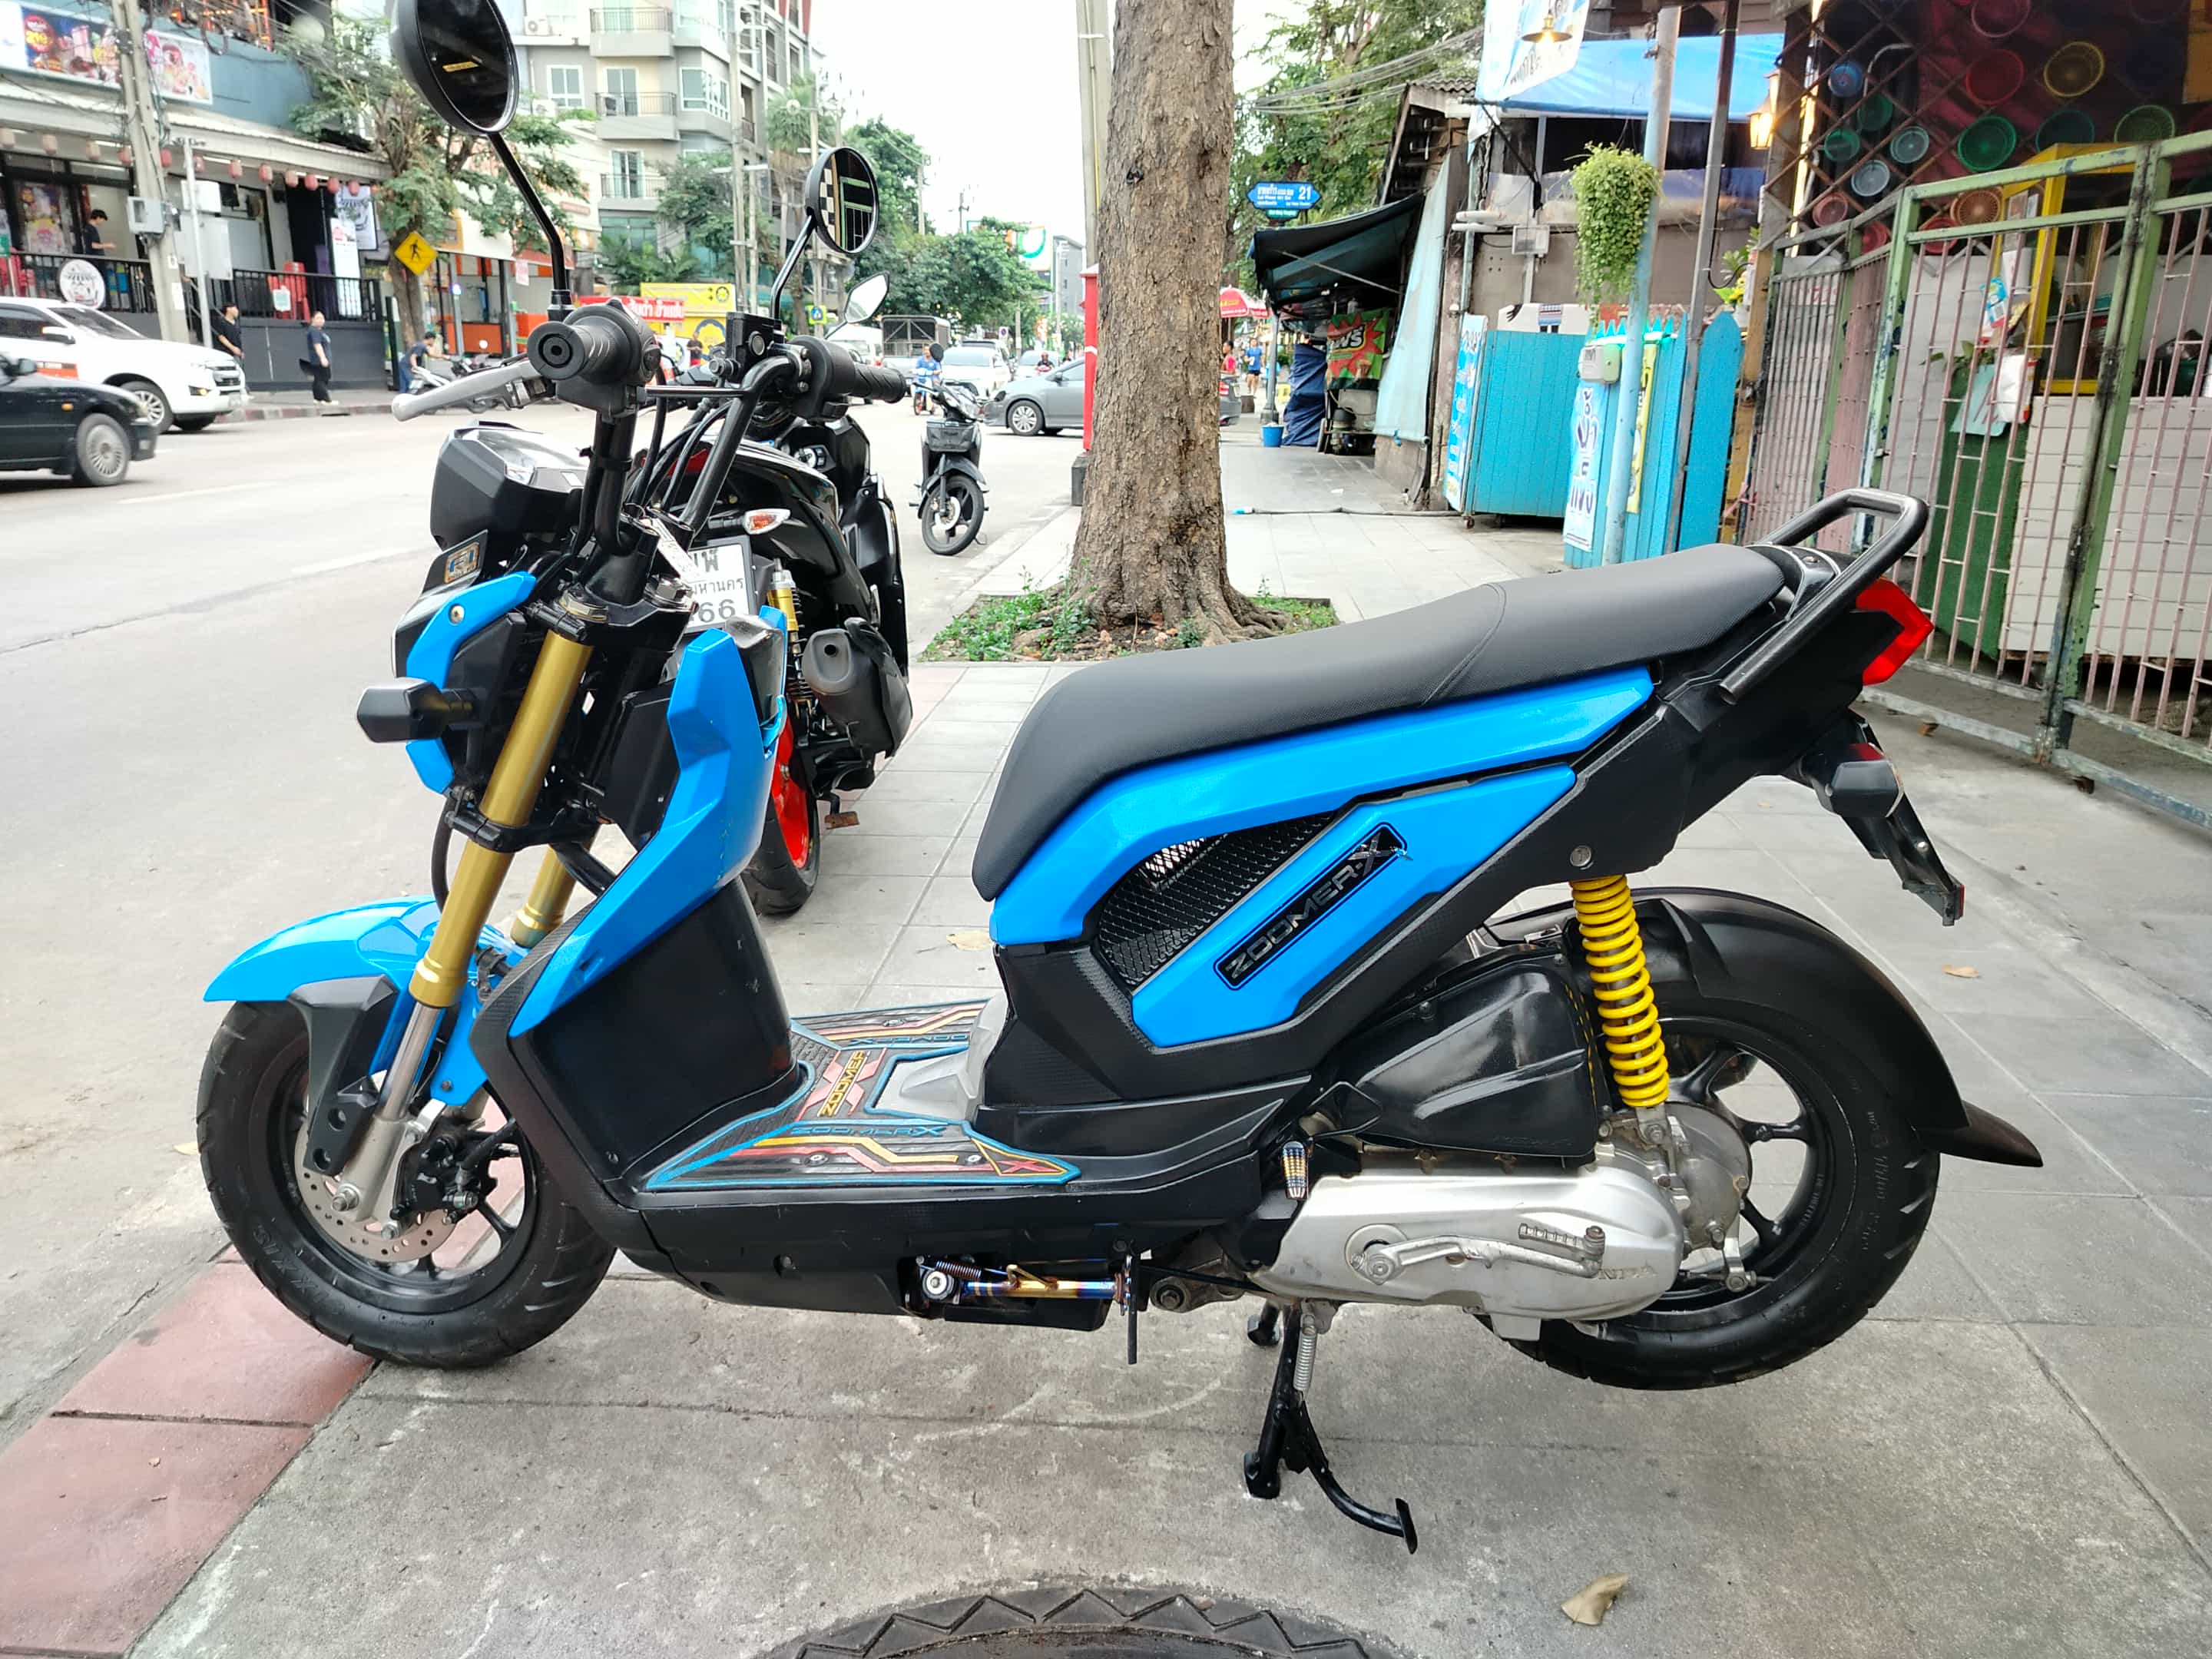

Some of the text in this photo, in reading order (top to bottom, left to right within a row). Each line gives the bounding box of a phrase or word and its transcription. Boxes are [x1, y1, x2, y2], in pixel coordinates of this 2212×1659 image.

[1298, 186, 1311, 200] 21
[1225, 833, 1414, 979] ZOOMER-X
[820, 1050, 866, 1118] ZOOMER
